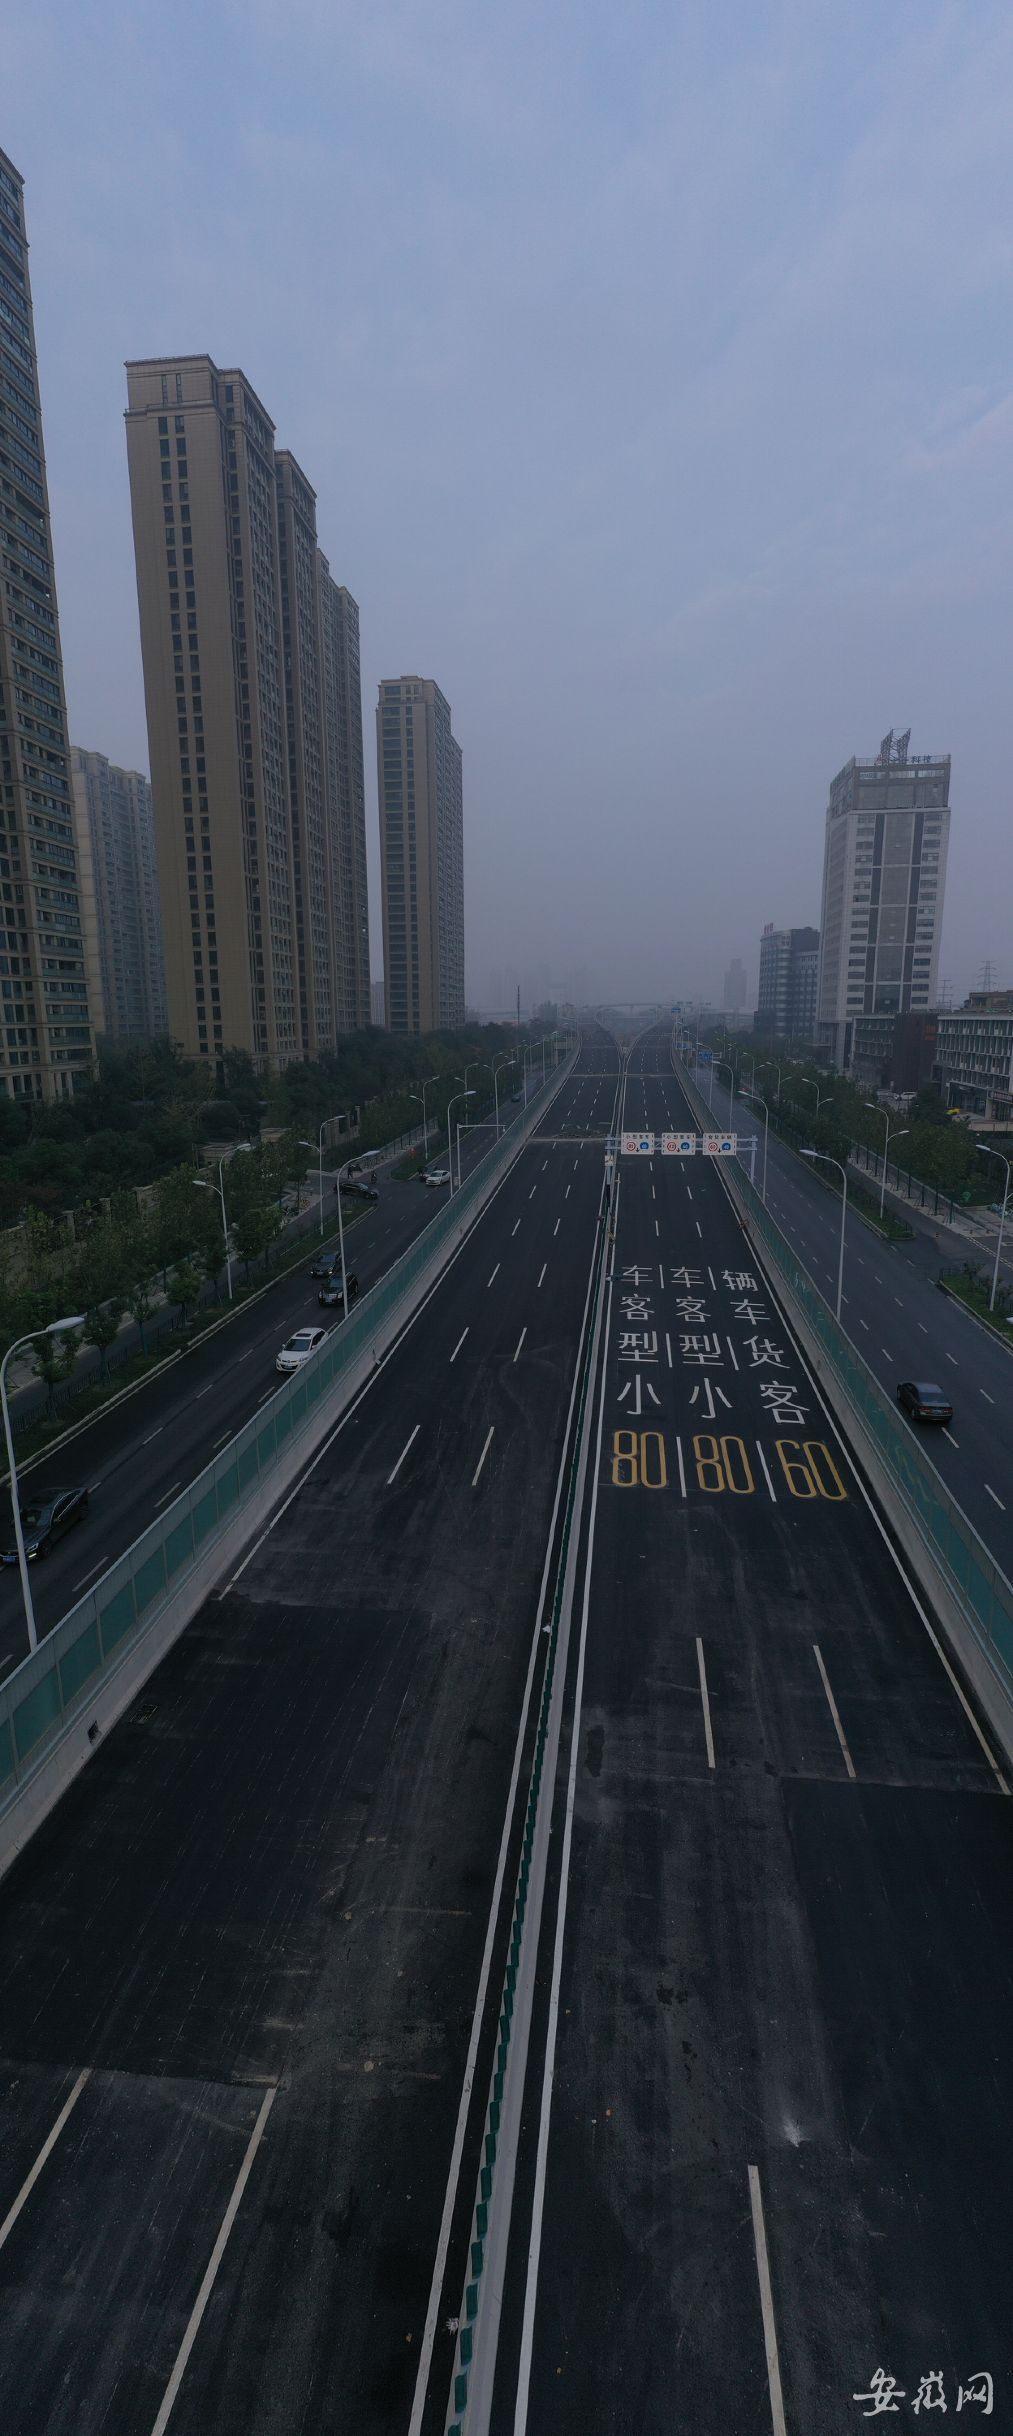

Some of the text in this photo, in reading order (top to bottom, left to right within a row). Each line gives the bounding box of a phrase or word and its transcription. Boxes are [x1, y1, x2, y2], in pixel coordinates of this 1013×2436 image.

[612, 1430, 667, 1488] 80
[692, 1435, 755, 1494] 80
[776, 1440, 849, 1500] 60
